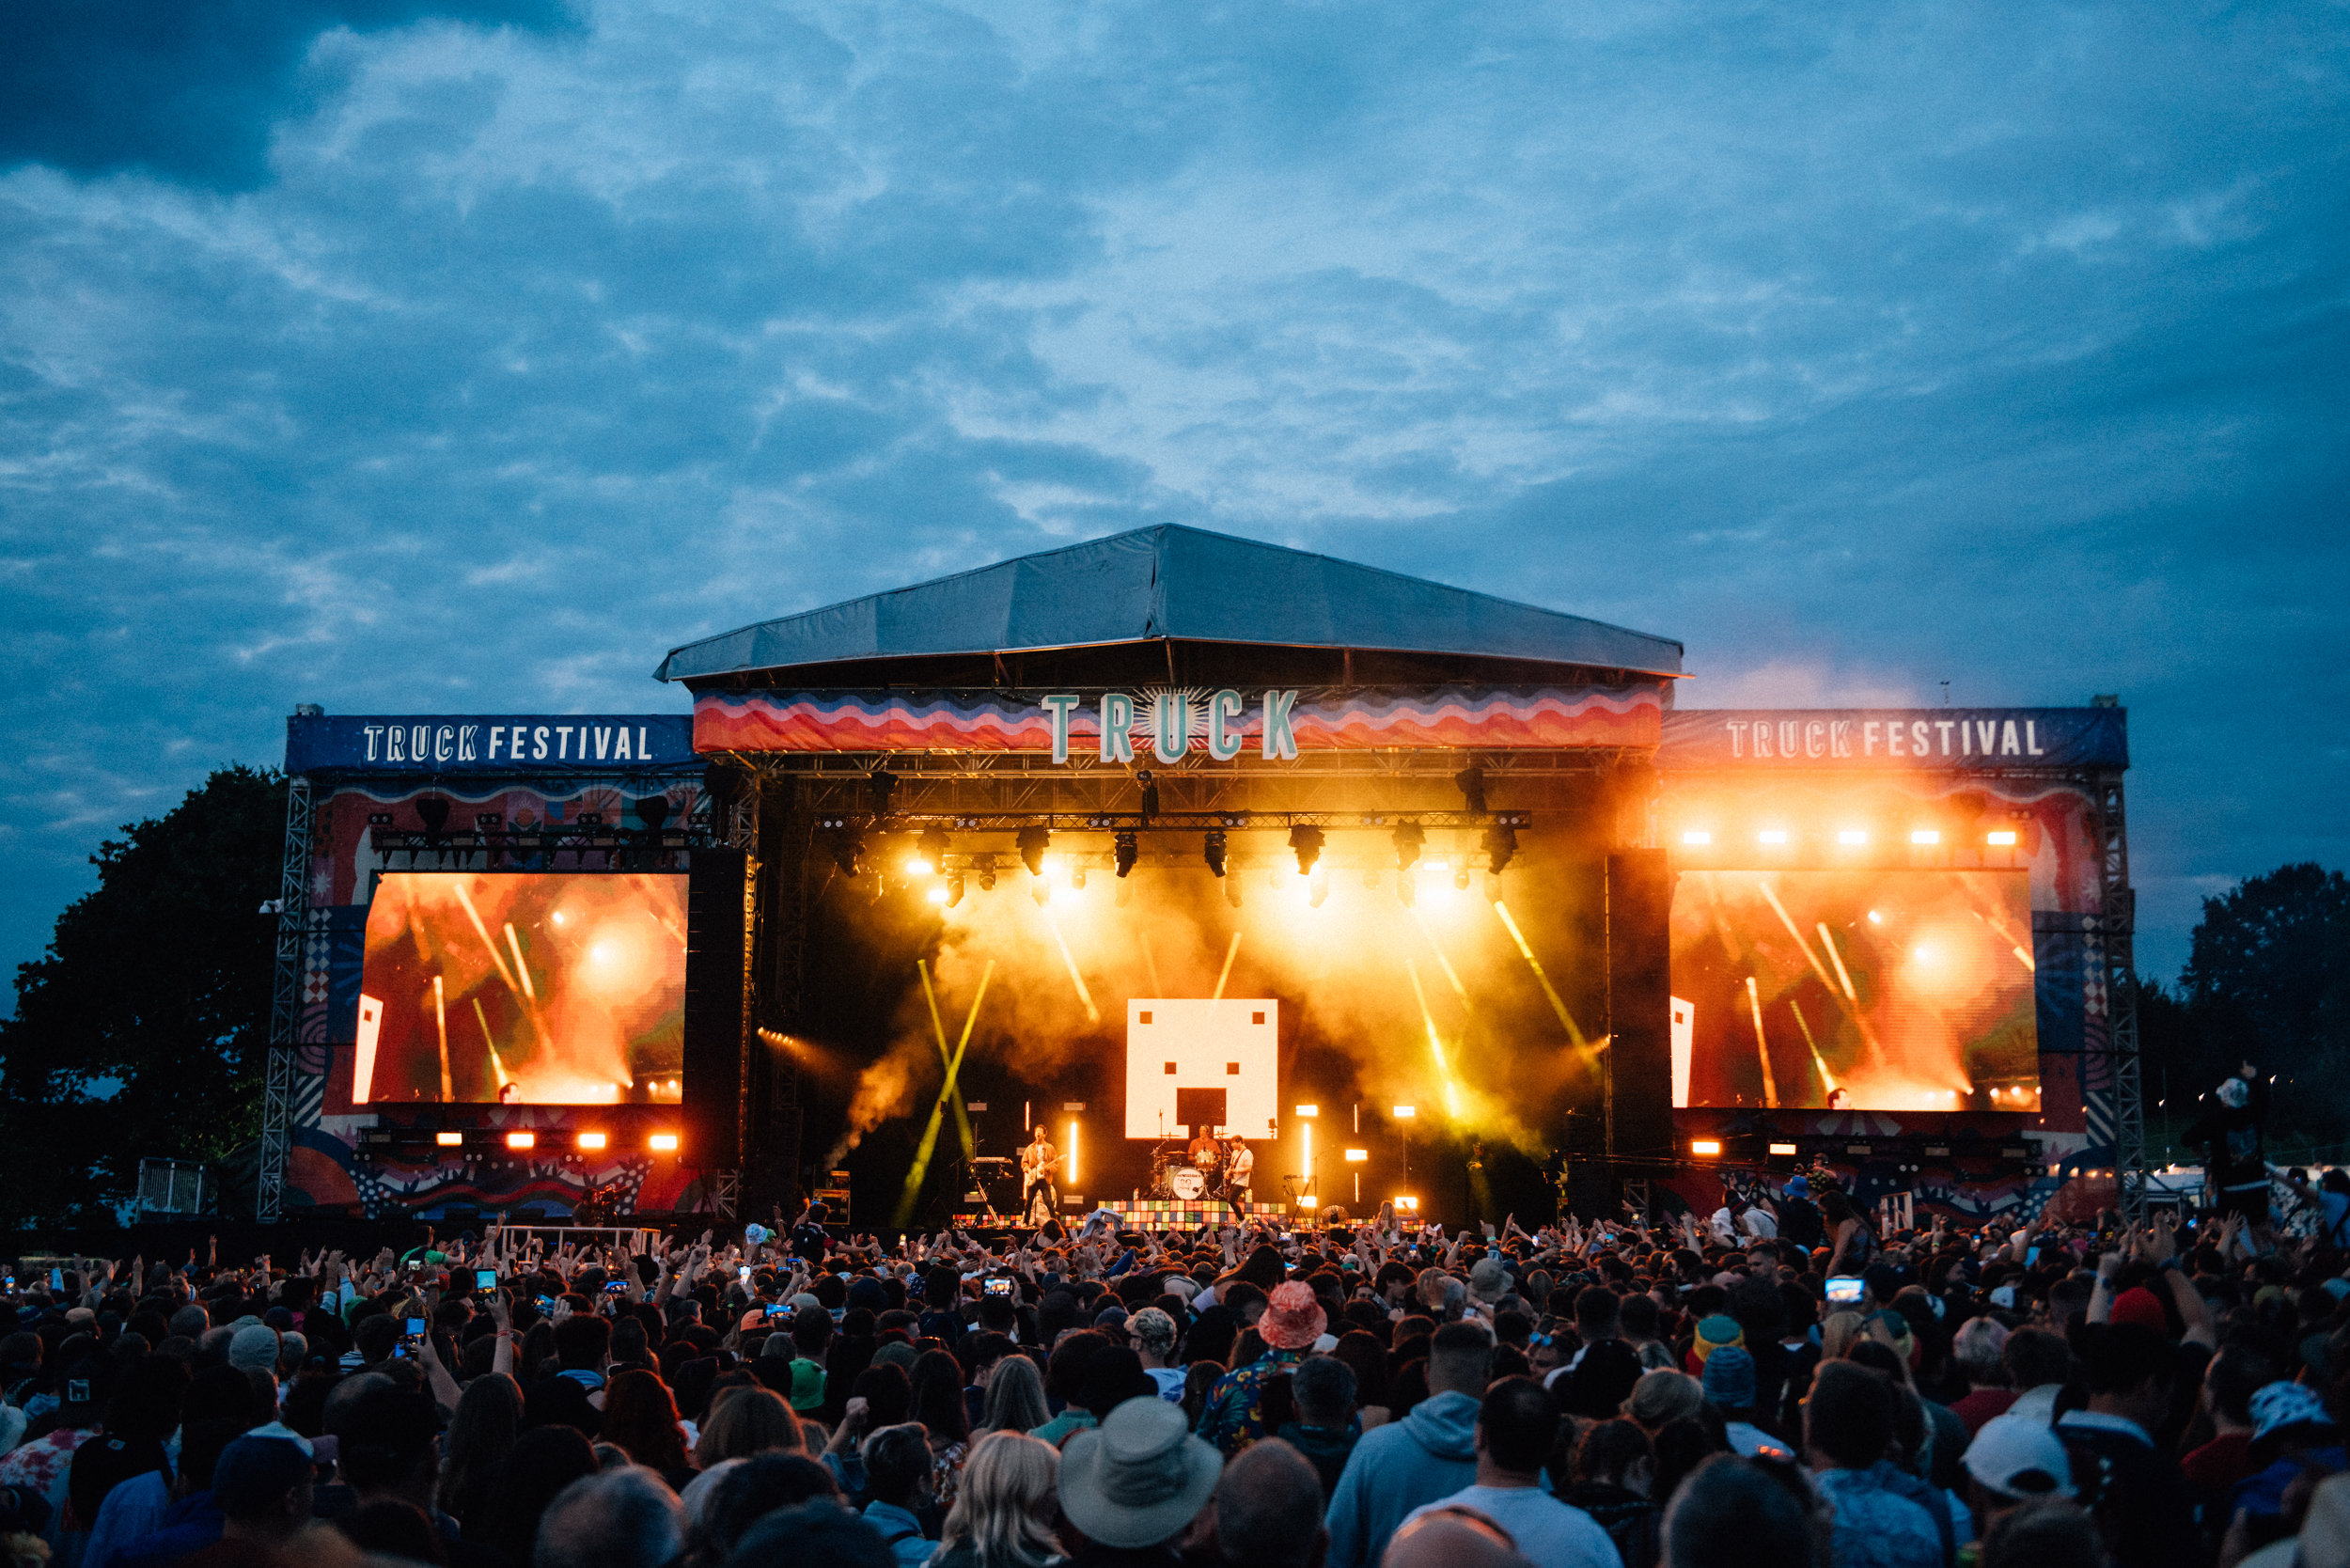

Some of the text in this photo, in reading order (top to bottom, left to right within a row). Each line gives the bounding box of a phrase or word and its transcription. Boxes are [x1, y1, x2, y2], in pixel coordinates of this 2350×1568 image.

[364, 725, 652, 761] TRUCK FESTIVAL
[1041, 689, 1299, 764] TRUCK
[1726, 719, 2044, 759] TRUCK FESTIVAL
